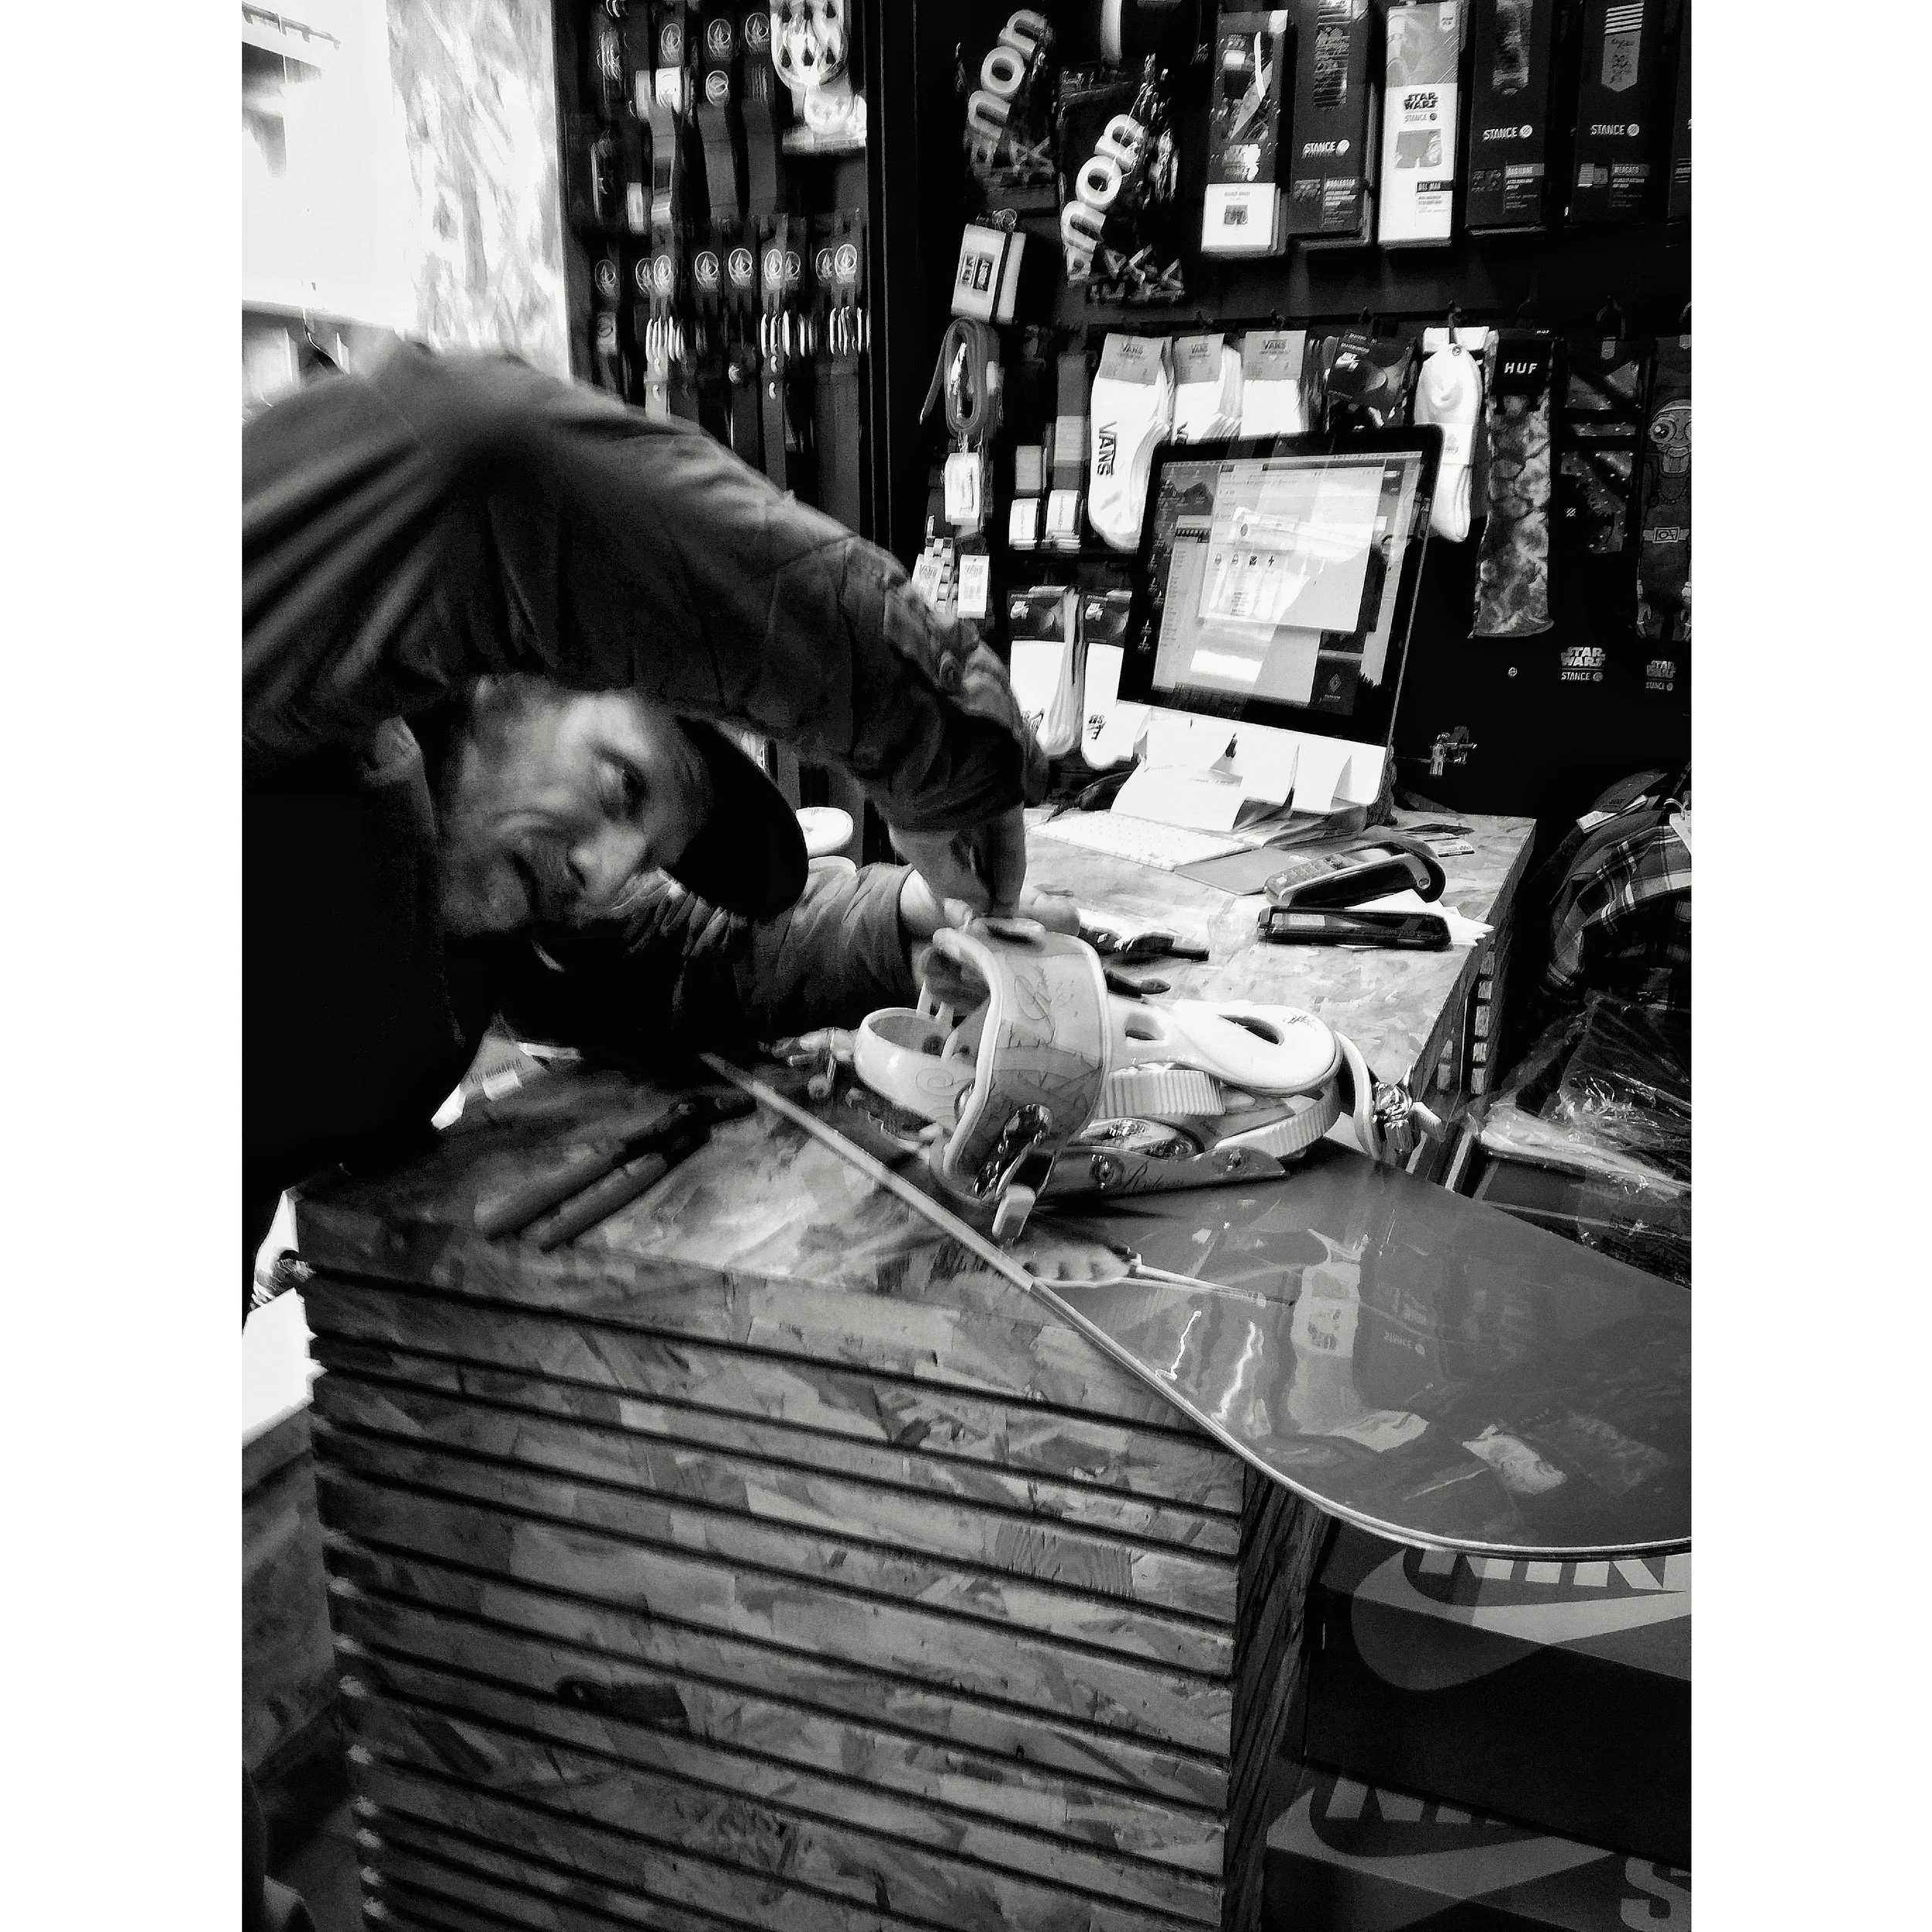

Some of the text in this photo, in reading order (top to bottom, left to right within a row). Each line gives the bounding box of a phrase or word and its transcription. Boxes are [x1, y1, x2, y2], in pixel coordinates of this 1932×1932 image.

[1405, 92, 1439, 102] STAR
[1403, 100, 1438, 110] WARS
[1403, 114, 1428, 124] STANCE
[1482, 127, 1518, 142] STANCE
[1590, 124, 1625, 136] STANCE
[1301, 141, 1336, 158] STANCE
[1262, 338, 1287, 349] VANS
[1504, 362, 1538, 375] HUF
[1097, 421, 1117, 476] VANS
[1561, 646, 1606, 657] STAR
[1561, 655, 1605, 667] WARS
[1560, 672, 1590, 682] STANCE
[1645, 682, 1665, 691] STANCE
